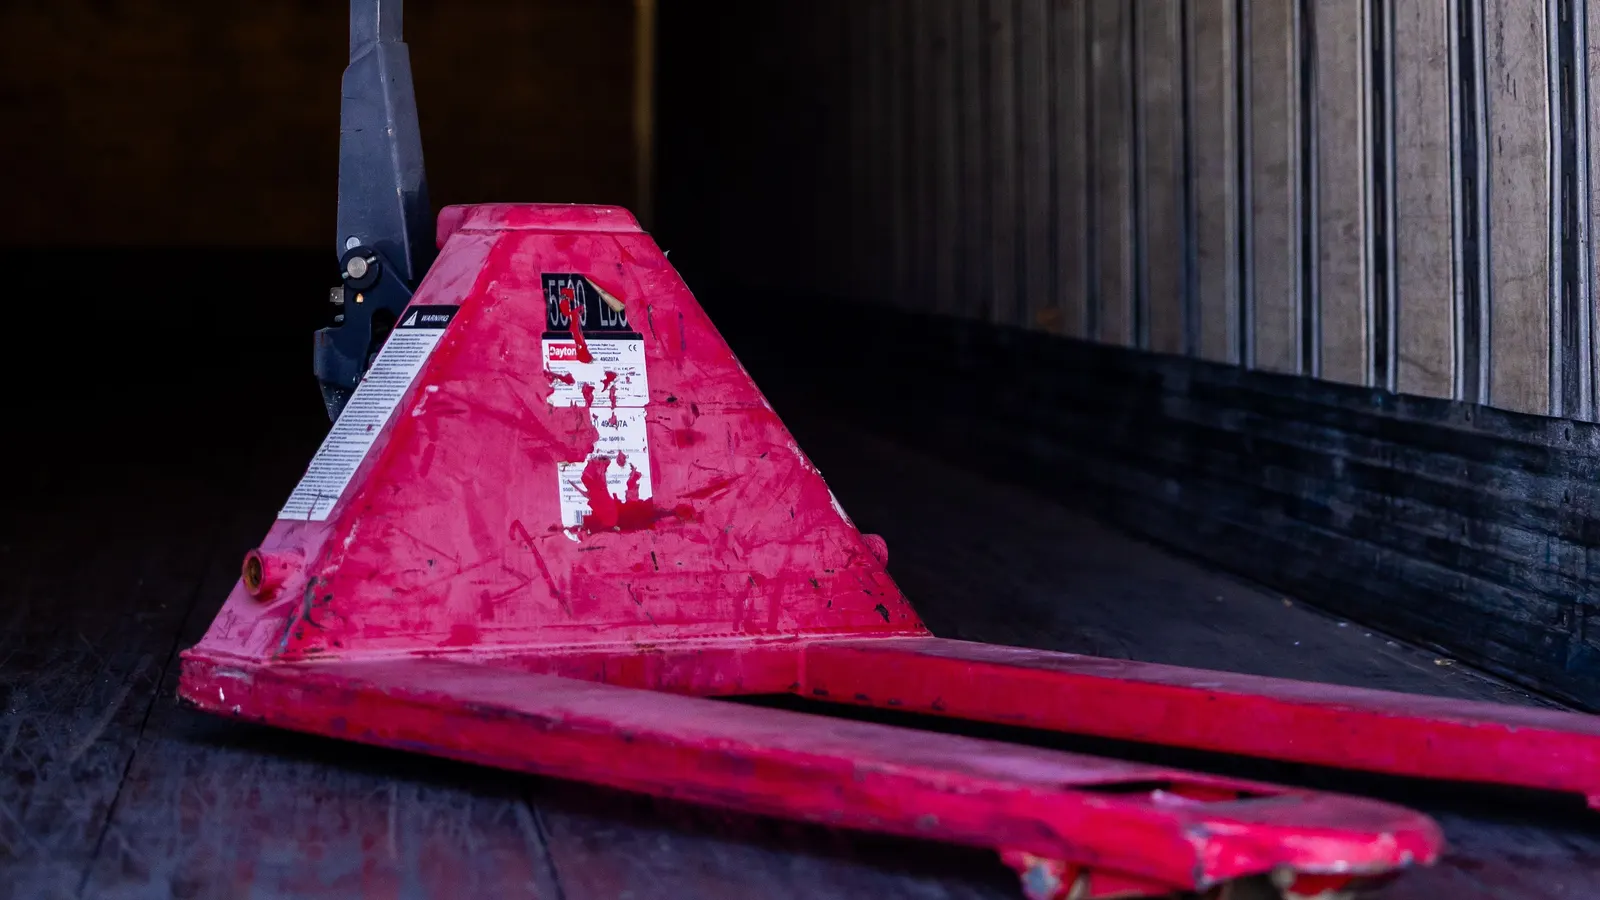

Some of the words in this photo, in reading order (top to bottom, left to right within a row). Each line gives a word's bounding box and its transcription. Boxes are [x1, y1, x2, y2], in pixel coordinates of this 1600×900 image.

[421, 314, 450, 322] WARNING
[628, 344, 637, 352] CE
[549, 346, 577, 359] Dayton
